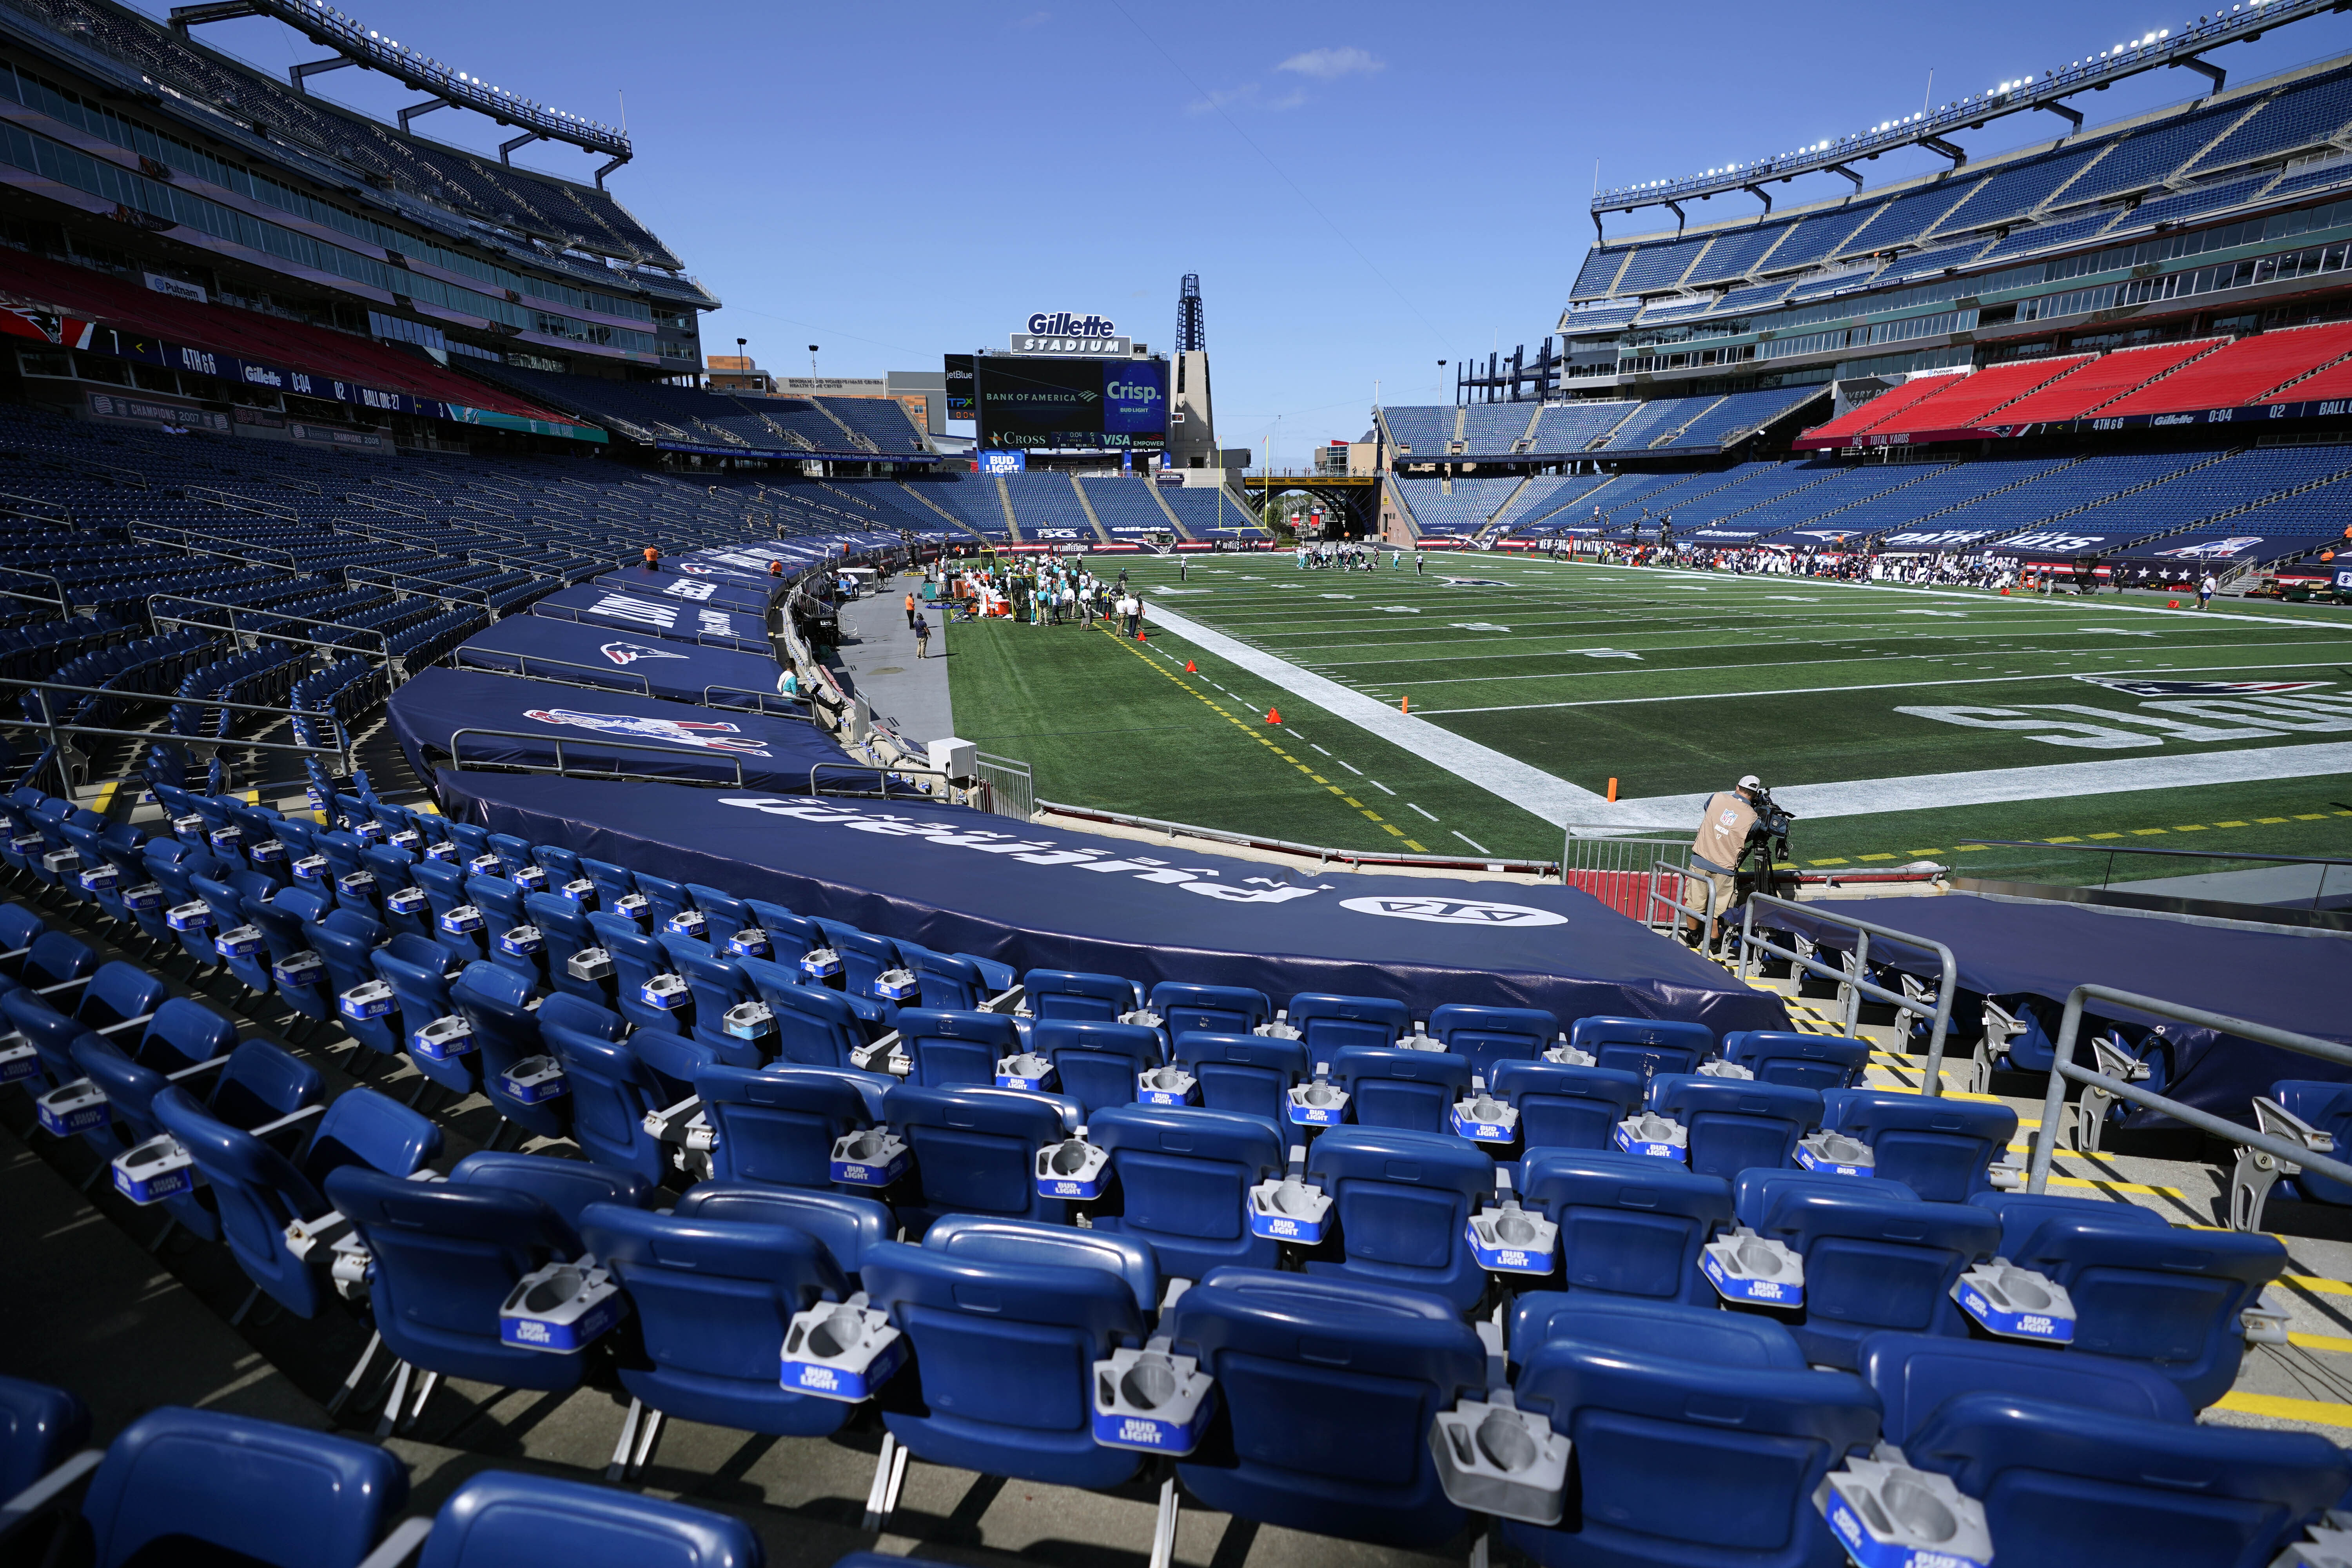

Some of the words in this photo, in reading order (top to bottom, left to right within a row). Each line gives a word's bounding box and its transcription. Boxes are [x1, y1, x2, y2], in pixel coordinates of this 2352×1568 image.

[165, 282, 198, 298] Putnam
[1028, 313, 1114, 337] Gillette
[1024, 339, 1119, 352] STADIUM
[946, 370, 973, 380] jetBlue
[245, 365, 281, 387] Gillette
[292, 372, 311, 394] 0:04
[334, 381, 346, 400] Q2
[1107, 381, 1161, 404] Crisp.
[1845, 390, 1870, 399] EVERY
[363, 389, 378, 408] BALL
[379, 392, 391, 409] ON:
[392, 395, 400, 410] 27
[947, 397, 973, 407] TPX
[131, 405, 176, 421] CHAMPIONS
[179, 411, 199, 423] 2007
[438, 403, 444, 418] 3
[2319, 400, 2345, 415] BALL
[2154, 414, 2194, 426] Gillette
[2208, 408, 2232, 422] 0:04
[2270, 404, 2285, 418] Q2
[549, 423, 561, 436] TOTAL
[561, 425, 574, 437] YARDS
[2041, 423, 2046, 434] 7
[334, 433, 361, 443] CHAMPIONS
[1101, 435, 1130, 445] VISA
[1852, 436, 1862, 446] 145
[1870, 435, 1887, 445] TOTAL
[1889, 433, 1909, 444] YARDS
[989, 456, 1015, 465] BUD
[985, 465, 1020, 473] LIGHT
[1539, 539, 1553, 549] NEW
[1886, 533, 1986, 543] PATR
[1995, 535, 2105, 550] IOTS
[662, 578, 717, 600] GEICO
[717, 798, 1320, 903] Putnam
[508, 1087, 522, 1096] LIGHT
[510, 1082, 520, 1090] BUD
[844, 1171, 868, 1180] LIGHT
[1274, 1219, 1294, 1227] BUD
[1269, 1225, 1298, 1236] LIGHT
[1497, 1256, 1529, 1266] LIGHT
[1501, 1250, 1524, 1259] BUD
[1748, 1287, 1783, 1298] LIGHT
[1754, 1281, 1779, 1291] BUD
[1966, 1298, 1987, 1317] LIGHT
[1969, 1293, 1987, 1309] BUD
[2024, 1315, 2051, 1325] BUD
[519, 1321, 545, 1333] BUD
[2016, 1321, 2054, 1334] LIGHT
[517, 1330, 550, 1343] LIGHT
[805, 1367, 833, 1379] BUD
[800, 1375, 837, 1390] LIGHT
[1125, 1419, 1156, 1433] BUD
[1120, 1428, 1162, 1444] LIGHT
[1914, 1552, 1957, 1568] BUD
